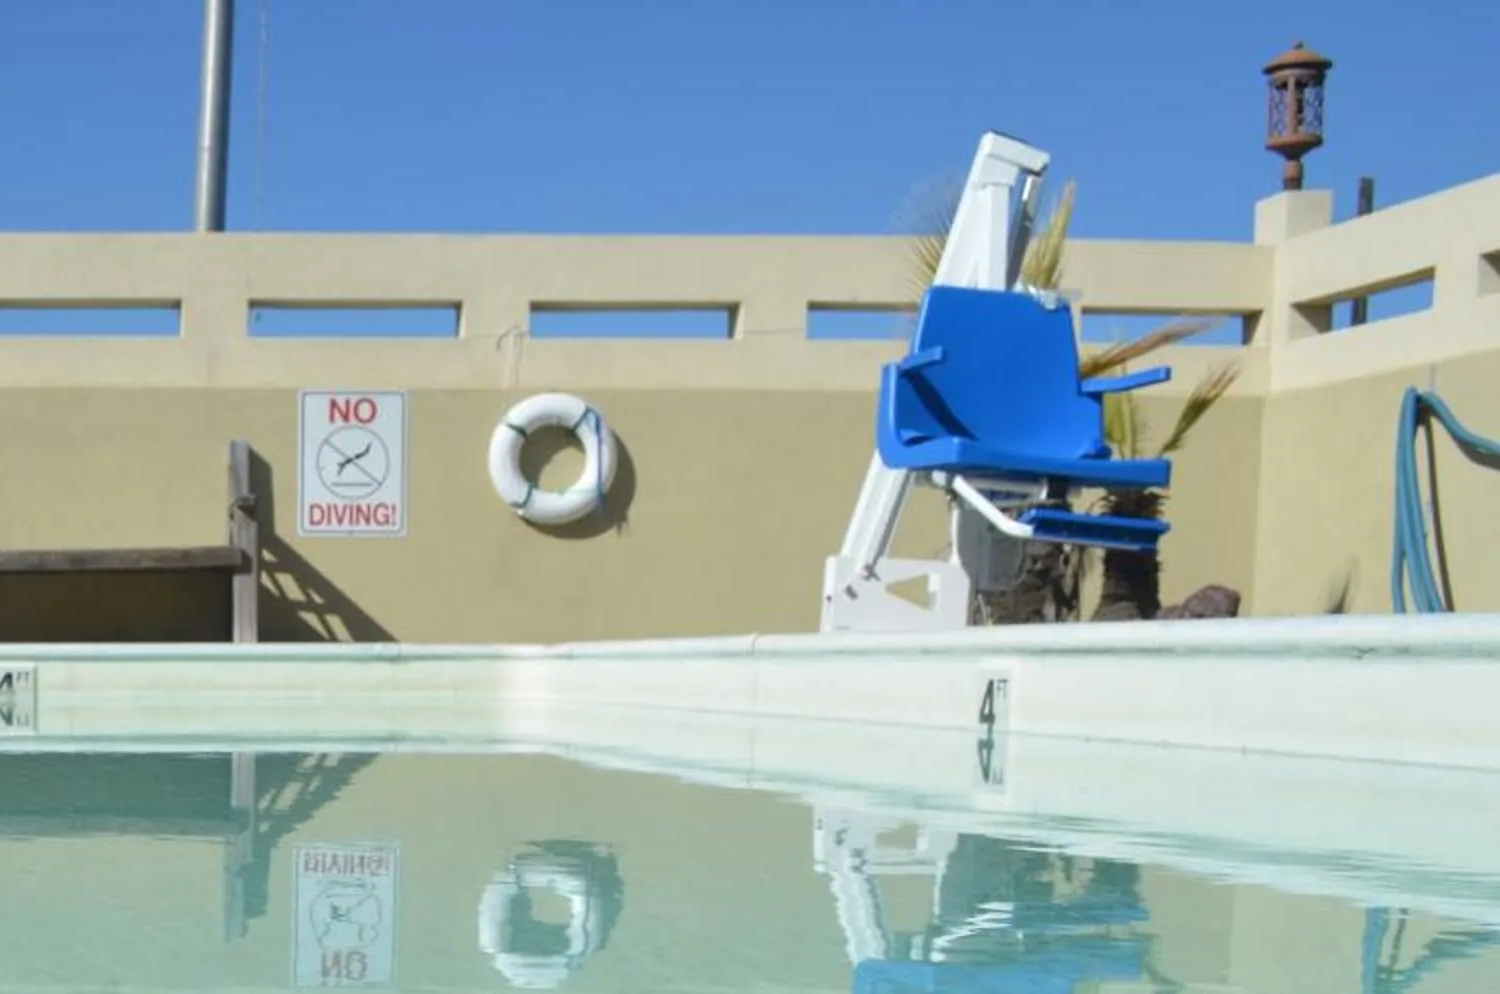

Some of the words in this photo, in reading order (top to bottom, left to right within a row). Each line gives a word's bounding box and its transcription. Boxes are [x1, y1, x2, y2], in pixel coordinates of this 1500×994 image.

[328, 397, 377, 425] NO
[308, 502, 397, 527] DIVING!
[979, 678, 996, 733] 4
